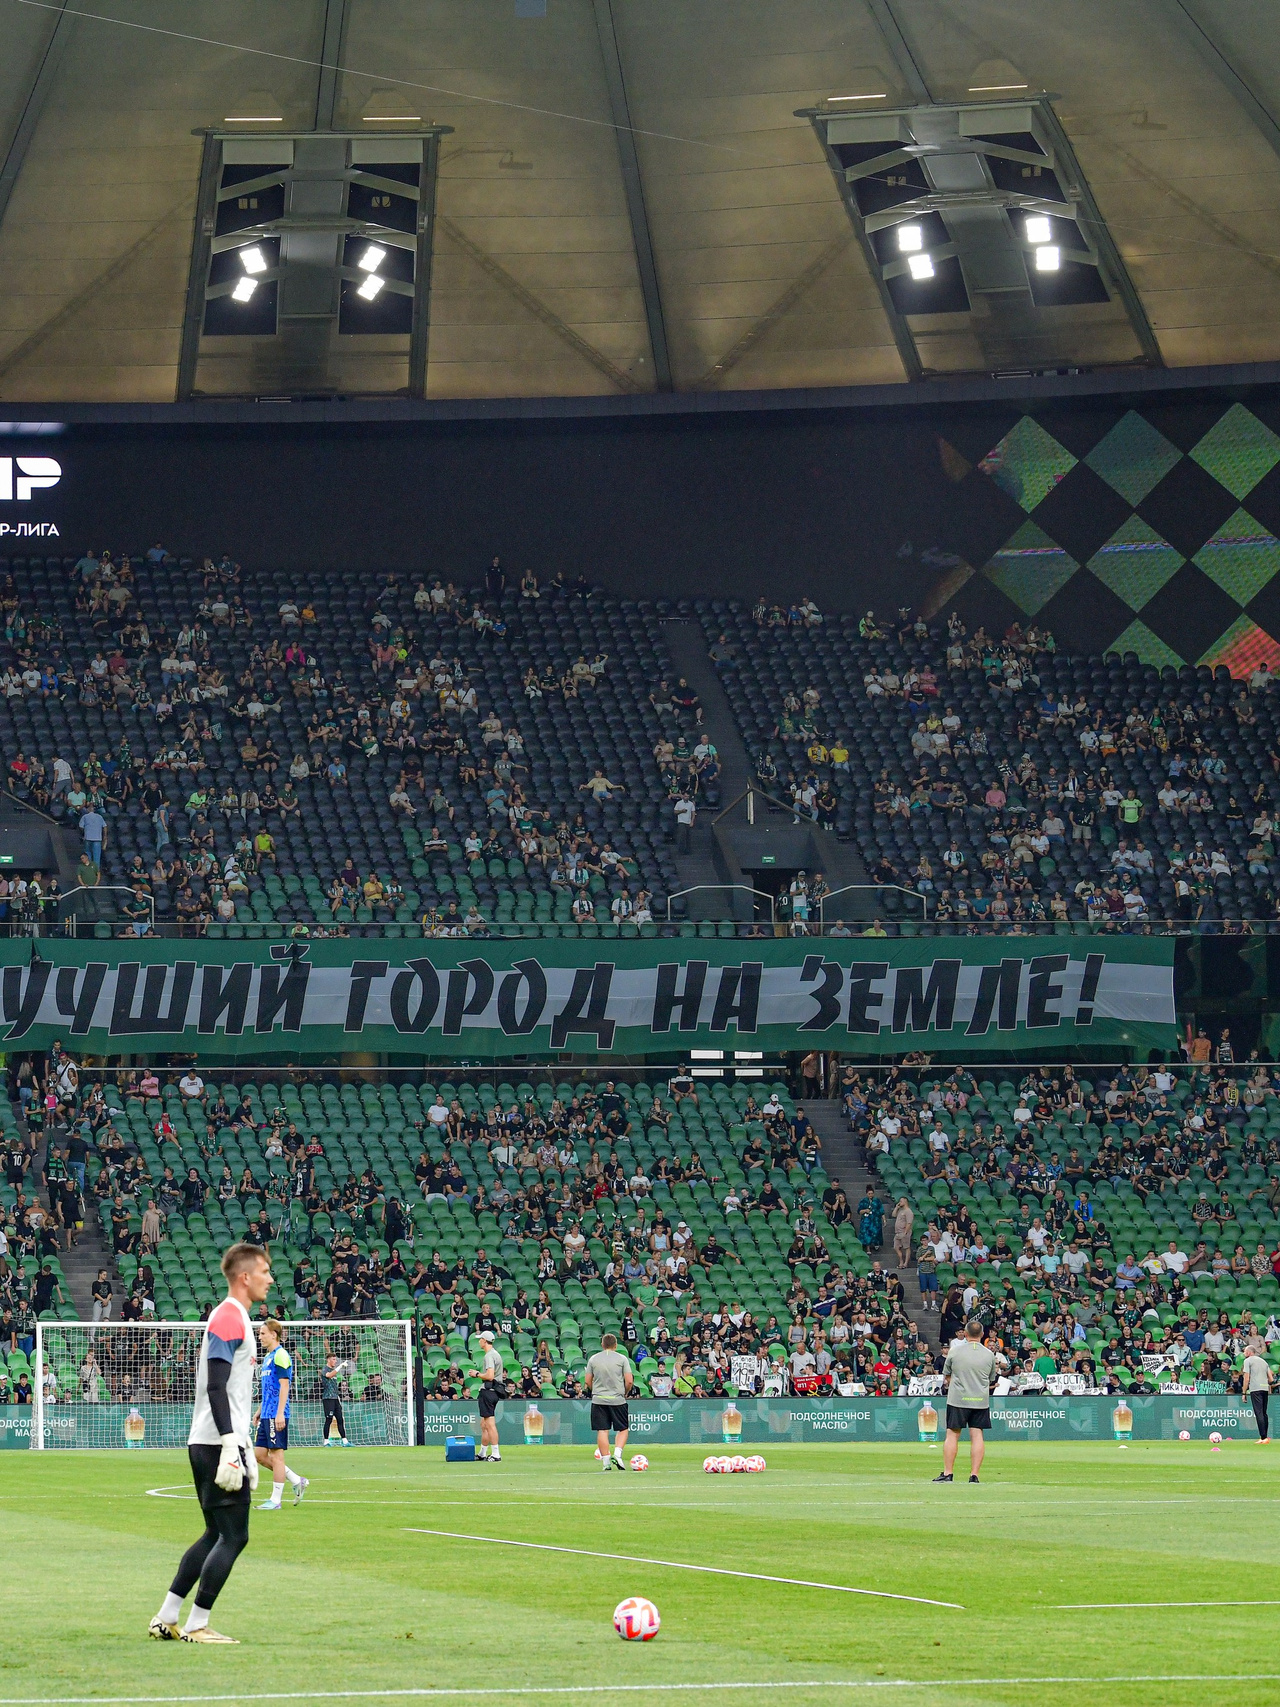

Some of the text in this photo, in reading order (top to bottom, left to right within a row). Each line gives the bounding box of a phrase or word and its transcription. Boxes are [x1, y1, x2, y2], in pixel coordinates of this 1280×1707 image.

[343, 957, 617, 1050] ГОРОД
[650, 960, 764, 1034] НА
[797, 953, 1107, 1036] ЗЕМЛЕ!
[13, 1154, 22, 1167] 10
[1160, 1383, 1190, 1393] НИКИТА
[628, 1413, 674, 1422] ЛНЕЧНОЕ
[790, 1411, 871, 1421] ПОДСОЛНЕЧНОЕ
[1179, 1409, 1257, 1419] ПОДСОЛНЕЧНО
[394, 1415, 476, 1424] ПООЛНЕЧНОЕ
[1008, 1419, 1044, 1428] МАСЛО
[1203, 1418, 1238, 1427] МАСЛО
[424, 1424, 453, 1433] АСЛО
[813, 1421, 848, 1429] МАСЛО
[15, 1428, 51, 1437] МАСО
